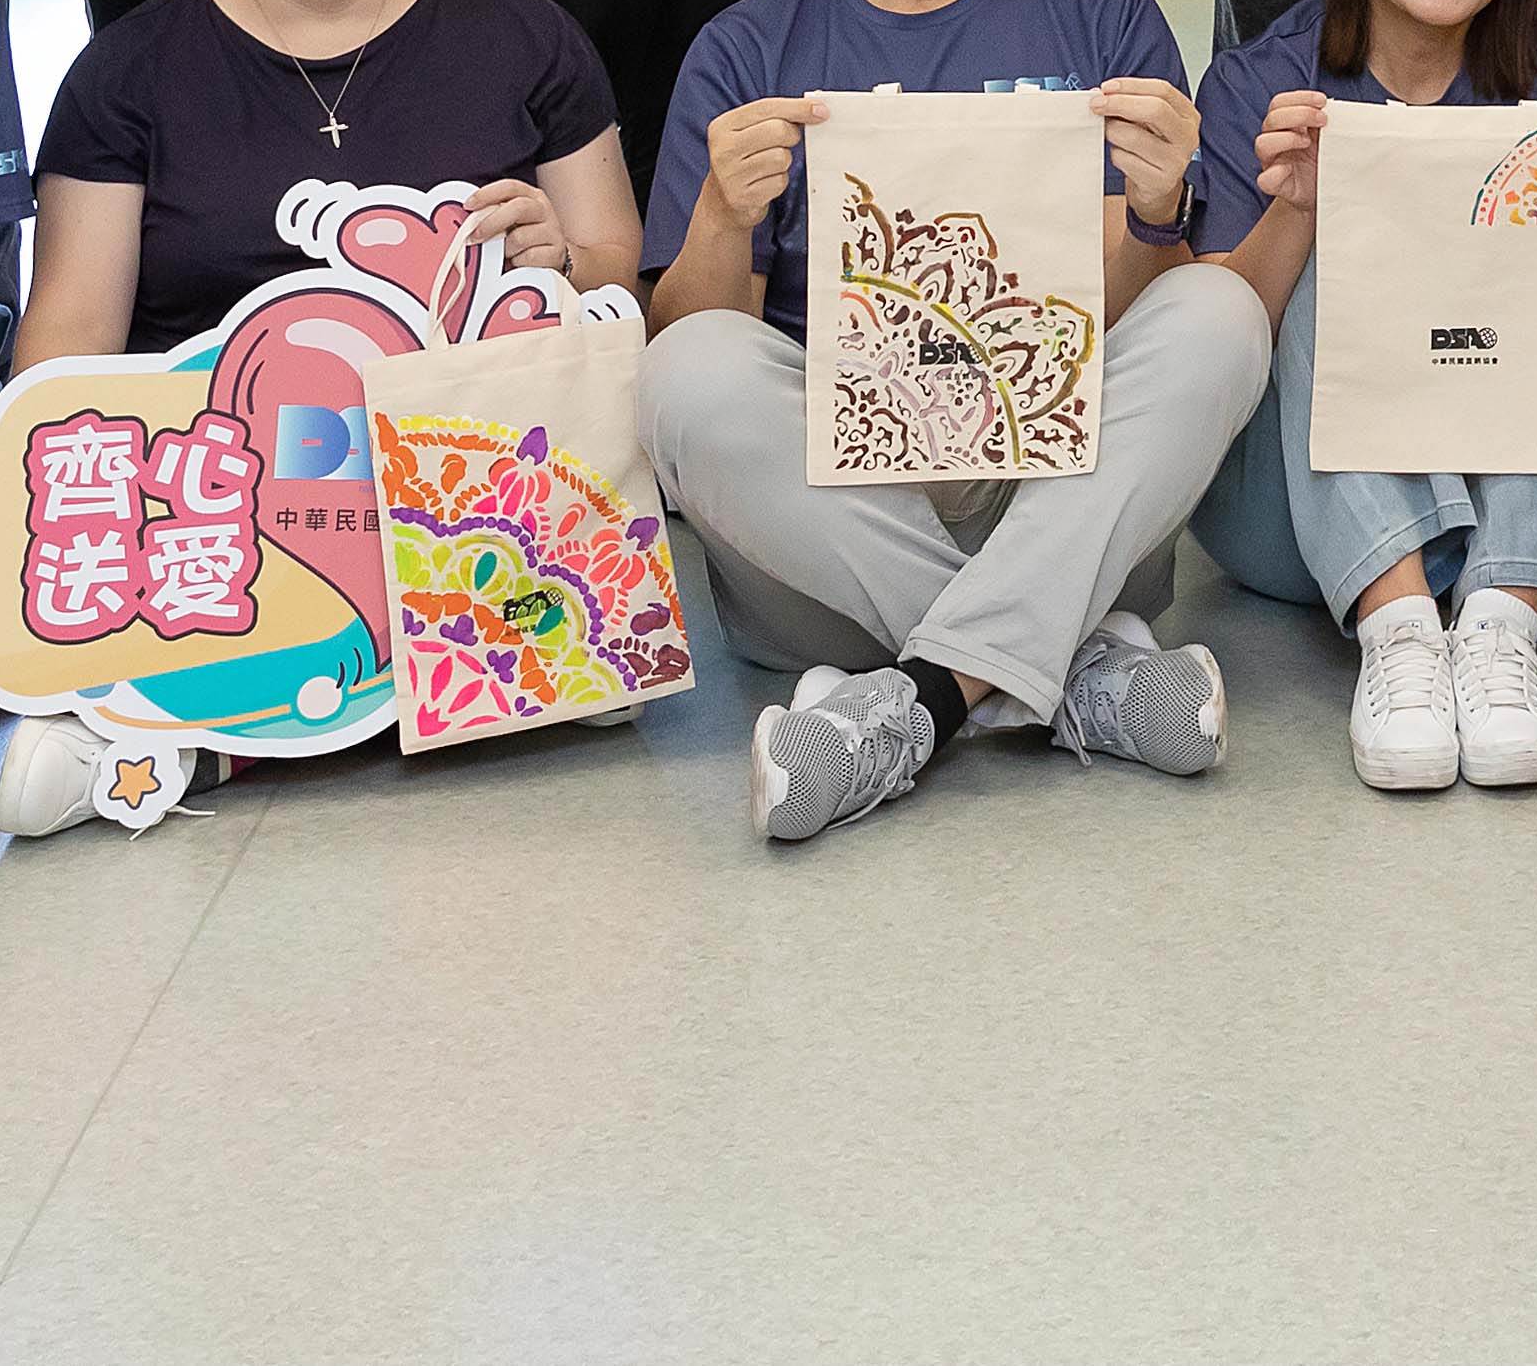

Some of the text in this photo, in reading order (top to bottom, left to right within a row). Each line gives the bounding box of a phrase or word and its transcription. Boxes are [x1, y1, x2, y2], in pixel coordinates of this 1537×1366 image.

[41, 421, 250, 521] 齊心
[275, 507, 382, 533] 中華民國
[35, 523, 246, 627] 送愛
